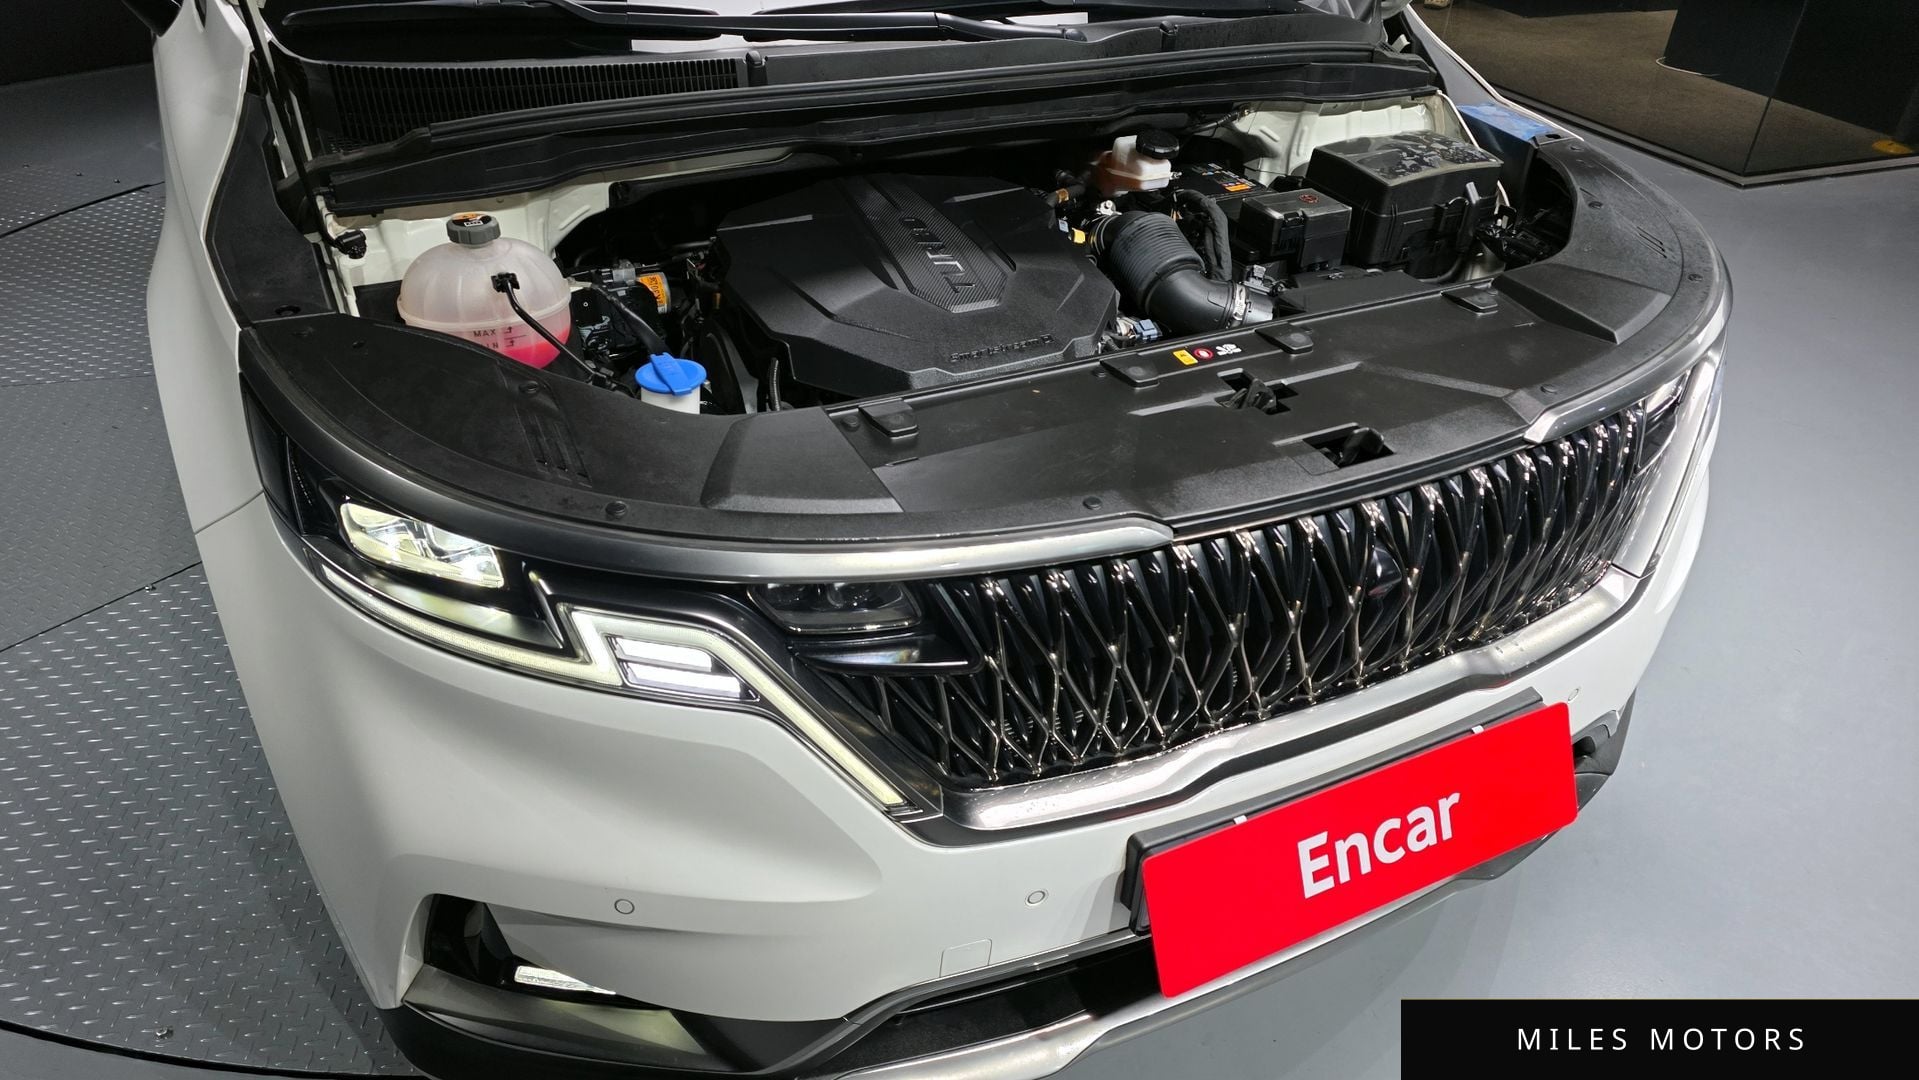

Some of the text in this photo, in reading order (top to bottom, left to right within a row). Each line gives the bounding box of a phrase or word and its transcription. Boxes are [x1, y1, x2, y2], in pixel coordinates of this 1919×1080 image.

[901, 216, 977, 294] TURBO
[473, 328, 496, 337] MAX
[1297, 791, 1461, 899] Encar
